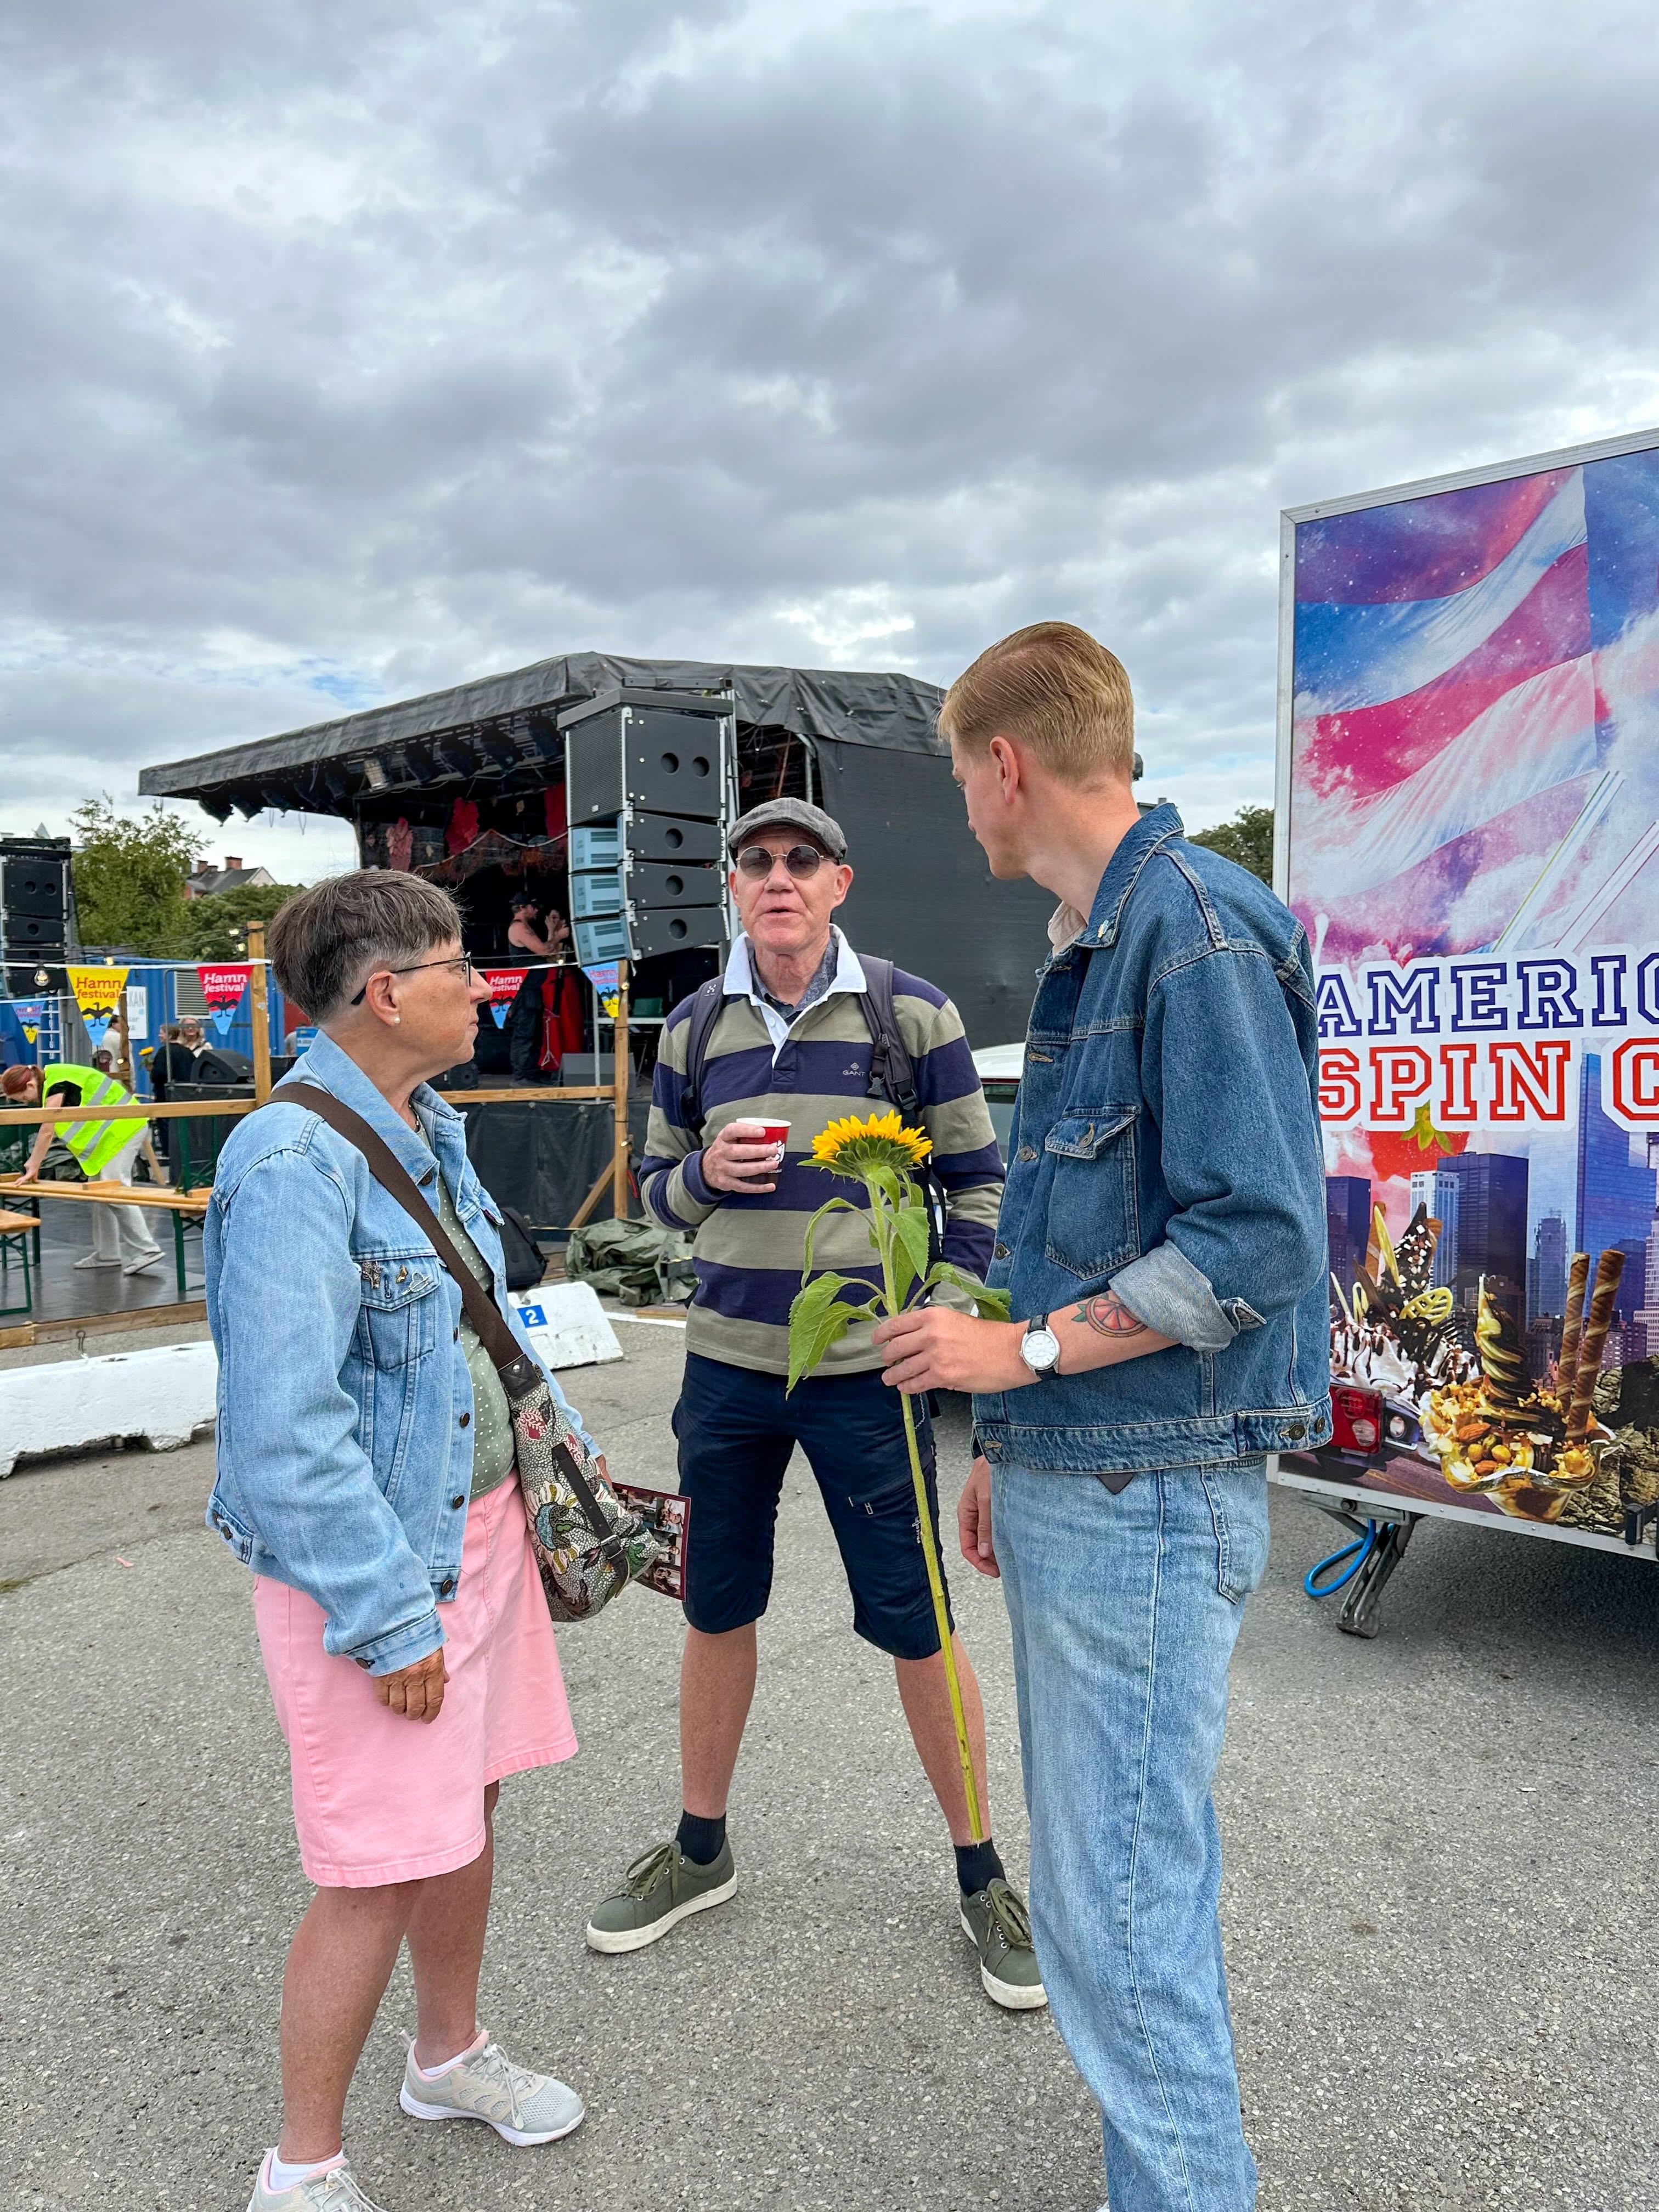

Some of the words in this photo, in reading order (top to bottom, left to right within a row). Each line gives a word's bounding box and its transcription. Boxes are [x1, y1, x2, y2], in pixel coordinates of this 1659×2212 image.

[76, 977, 122, 989] Hamn
[204, 973, 247, 984] Hamn
[489, 975, 523, 985] Hamn
[77, 989, 120, 999] festival
[204, 983, 244, 994] festival
[1319, 1041, 1571, 1121] SPIN
[526, 1309, 539, 1324] 2
